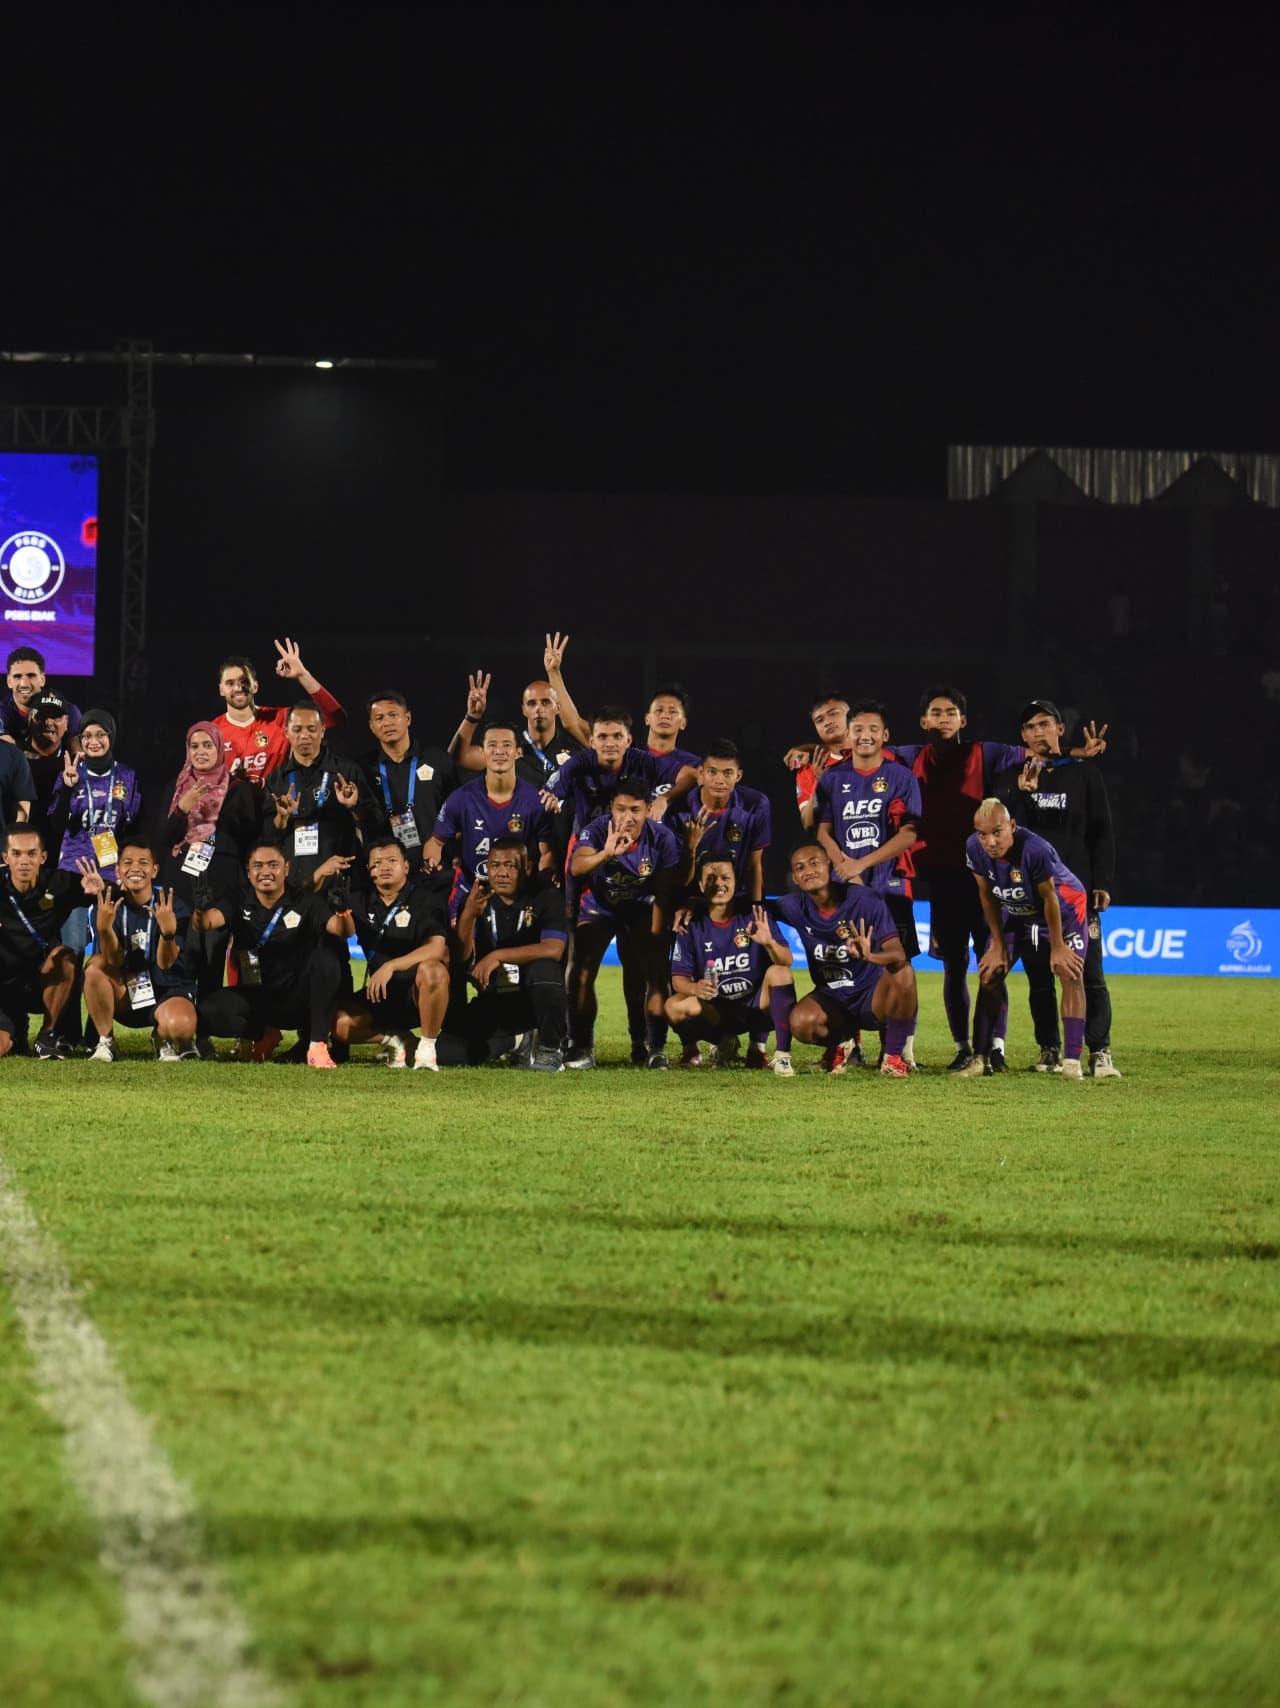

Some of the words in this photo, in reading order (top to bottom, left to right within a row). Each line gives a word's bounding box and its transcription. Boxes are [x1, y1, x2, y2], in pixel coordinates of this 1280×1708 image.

[842, 799, 882, 816] AFG
[851, 826, 875, 839] WBI
[992, 886, 1025, 899] AFG
[1102, 928, 1187, 959] GUE
[712, 953, 749, 972] AFG
[722, 981, 748, 994] WBI
